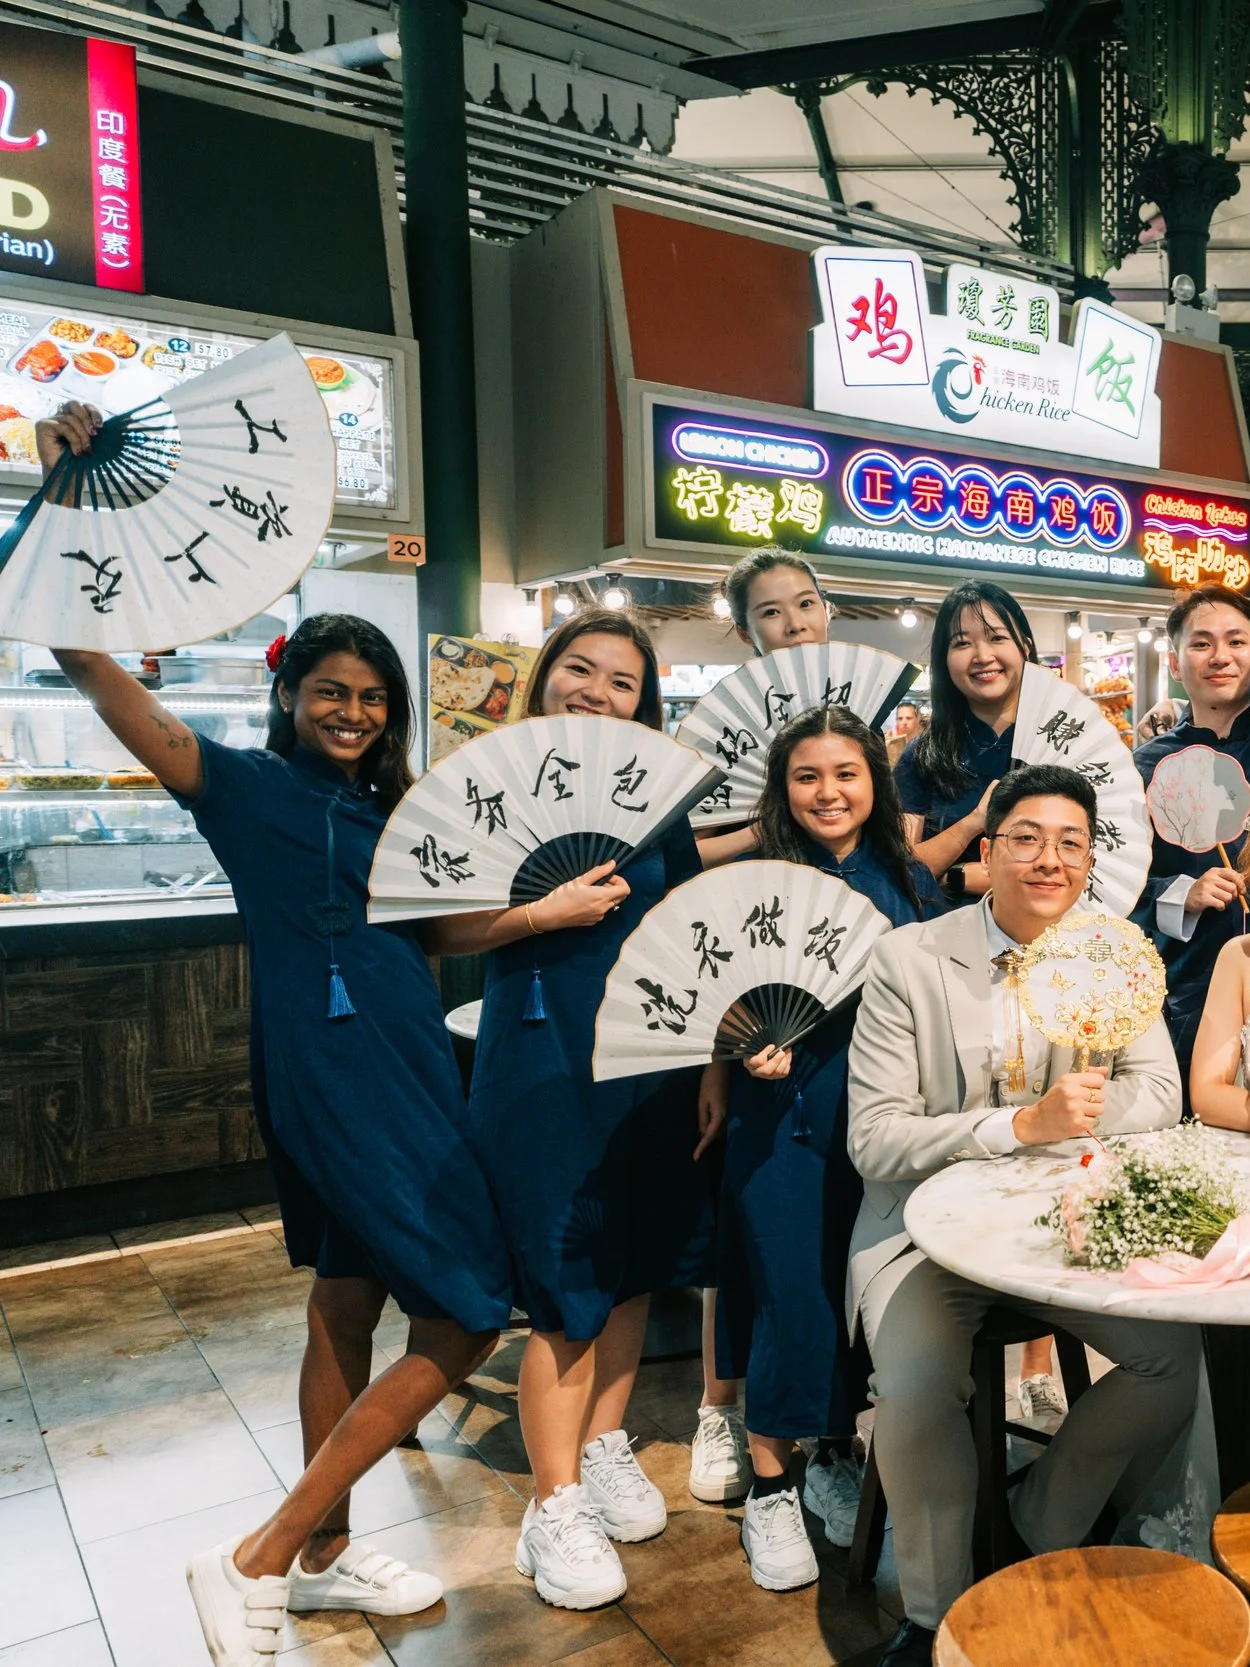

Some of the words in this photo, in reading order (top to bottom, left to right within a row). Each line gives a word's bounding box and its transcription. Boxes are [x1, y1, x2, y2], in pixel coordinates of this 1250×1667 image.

[846, 277, 914, 365] 鸡
[171, 340, 189, 352] 12
[199, 345, 229, 358] $7.80
[966, 329, 1010, 349] FRAGRANCE
[1011, 339, 1040, 355] GARDEN
[187, 359, 206, 370] SET
[1085, 337, 1137, 418] 饭
[340, 414, 357, 425] 14
[1035, 398, 1071, 422] Rice
[338, 477, 365, 488] $6.80
[860, 467, 1118, 538] 正宗海南鸡饭
[1145, 494, 1203, 520] Chicken
[394, 541, 421, 557] 20
[826, 526, 934, 555] AUTHENTIC
[936, 537, 1036, 566] HAINANESE
[1037, 549, 1108, 573] CHICKEN
[1109, 557, 1145, 577] RICE
